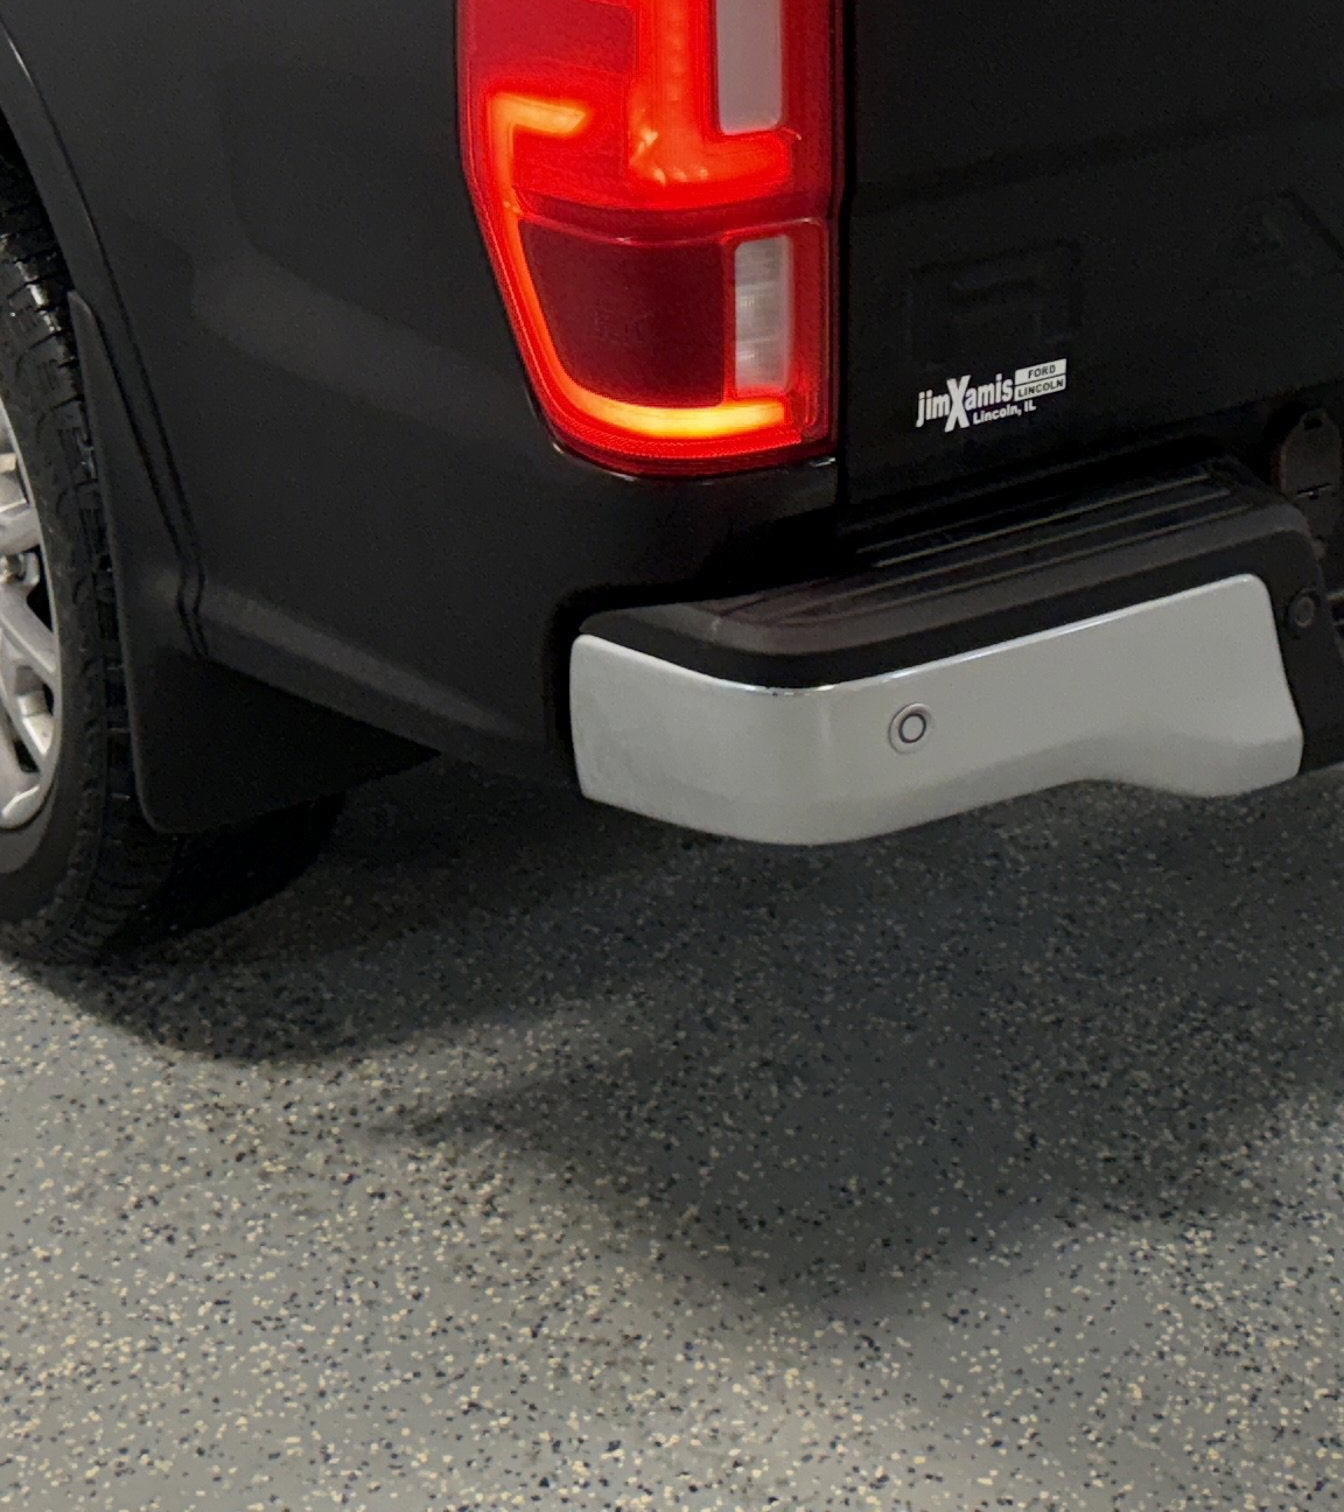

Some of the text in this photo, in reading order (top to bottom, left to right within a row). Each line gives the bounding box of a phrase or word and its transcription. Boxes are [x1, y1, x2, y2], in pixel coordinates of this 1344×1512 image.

[1028, 364, 1056, 379] FORD
[1018, 378, 1064, 398] LINCOLN
[973, 400, 1036, 424] Lincoln, IL
